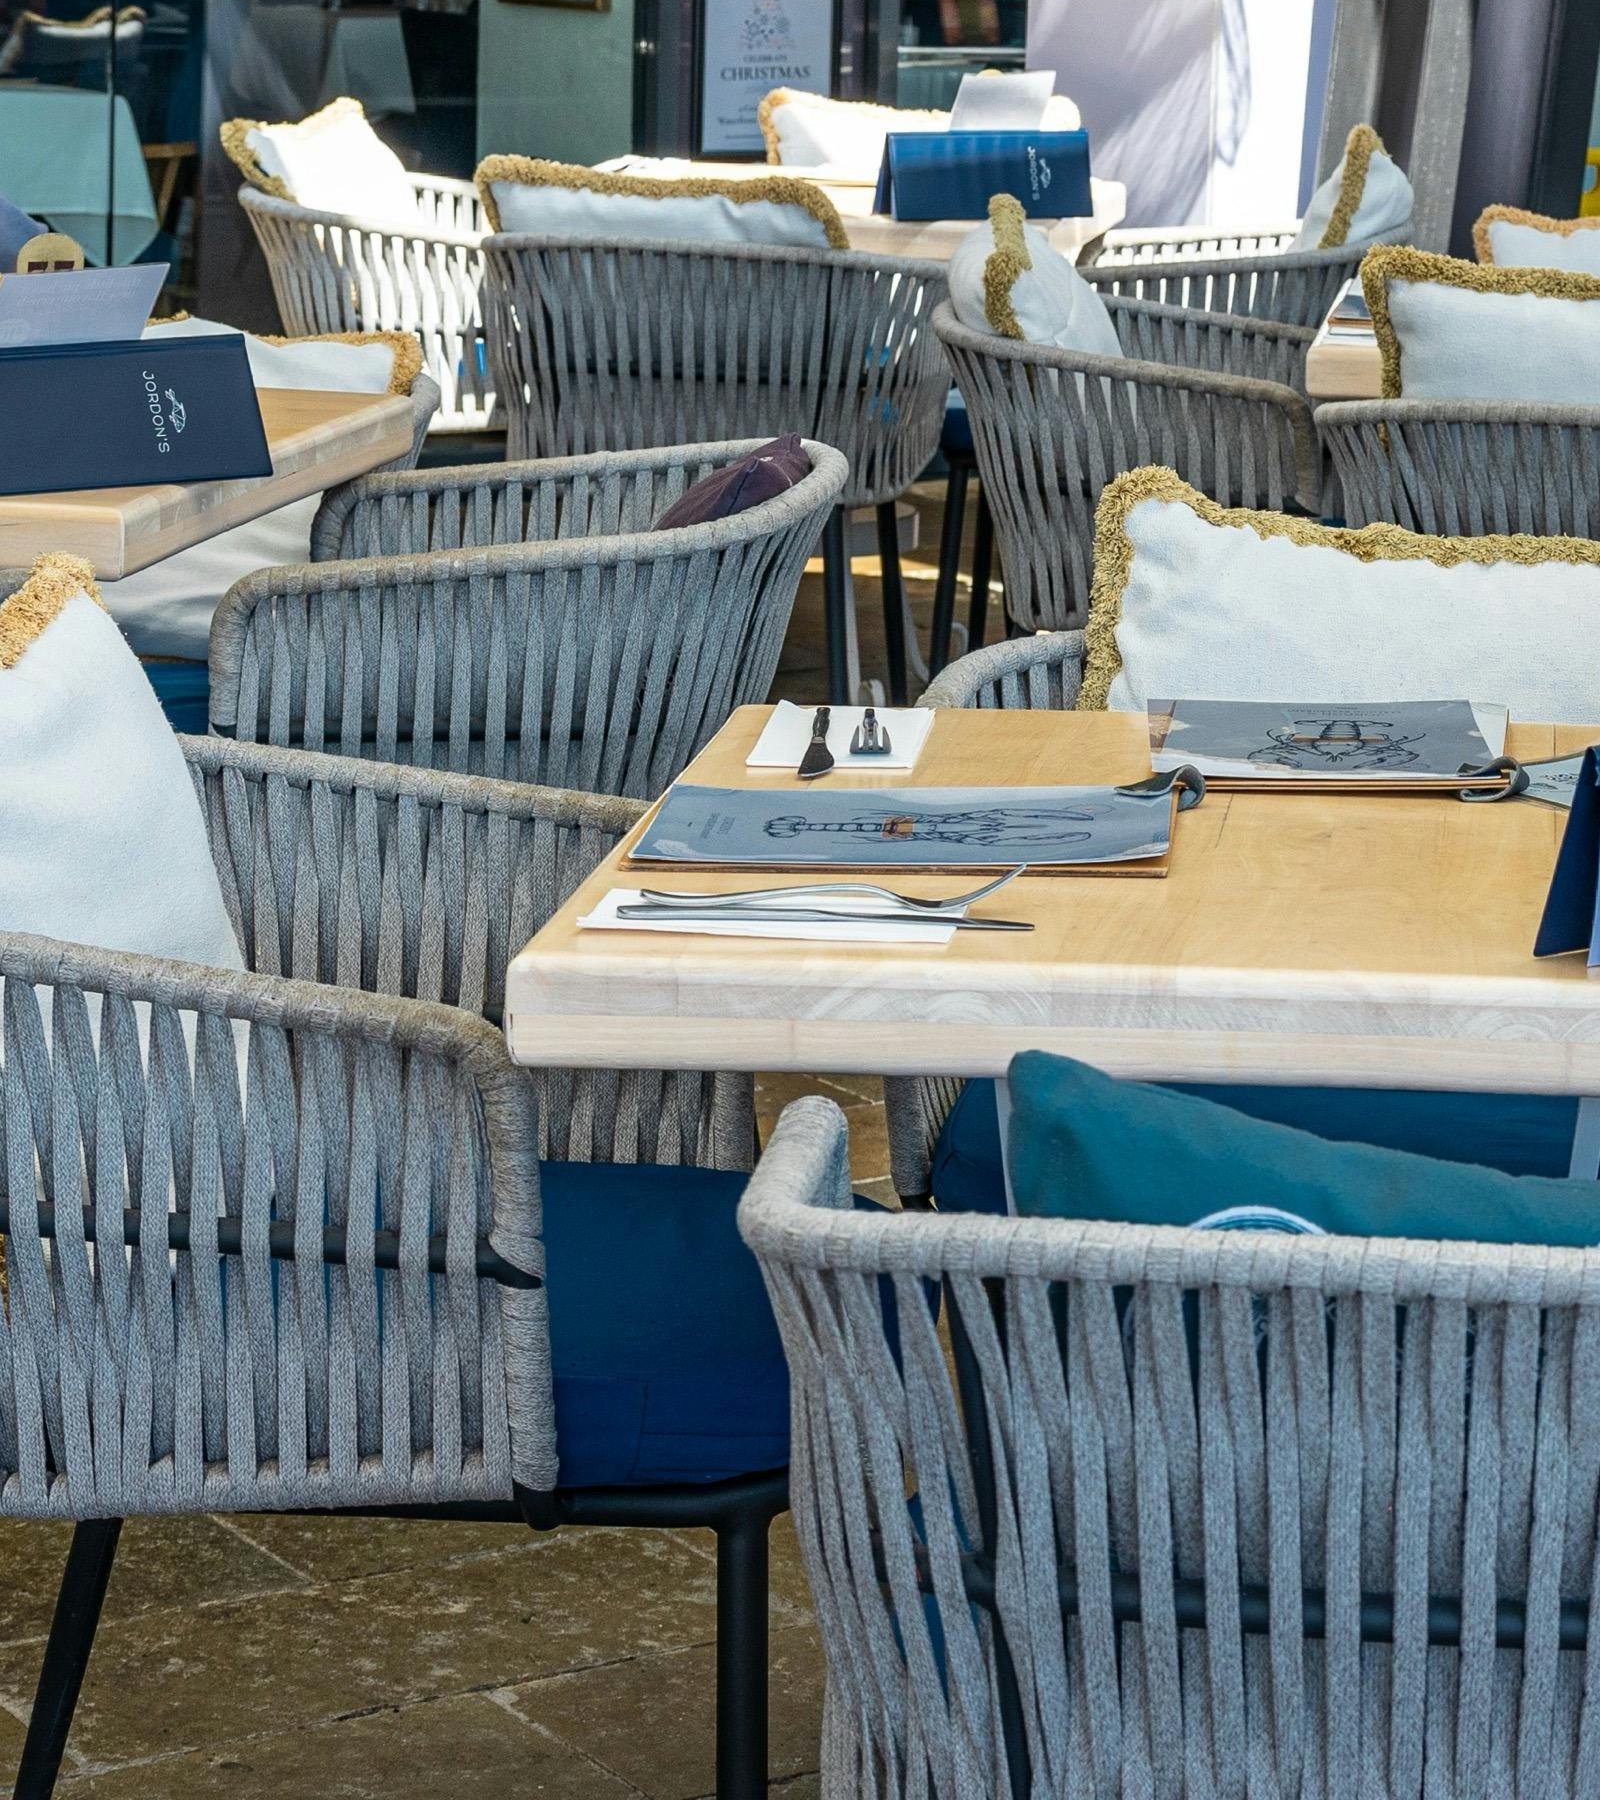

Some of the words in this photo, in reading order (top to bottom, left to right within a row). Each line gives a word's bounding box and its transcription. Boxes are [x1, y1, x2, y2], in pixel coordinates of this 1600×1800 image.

[720, 65, 811, 82] CHRISTMAS
[1027, 145, 1040, 201] JORDON'S
[142, 370, 170, 453] JORDON'S
